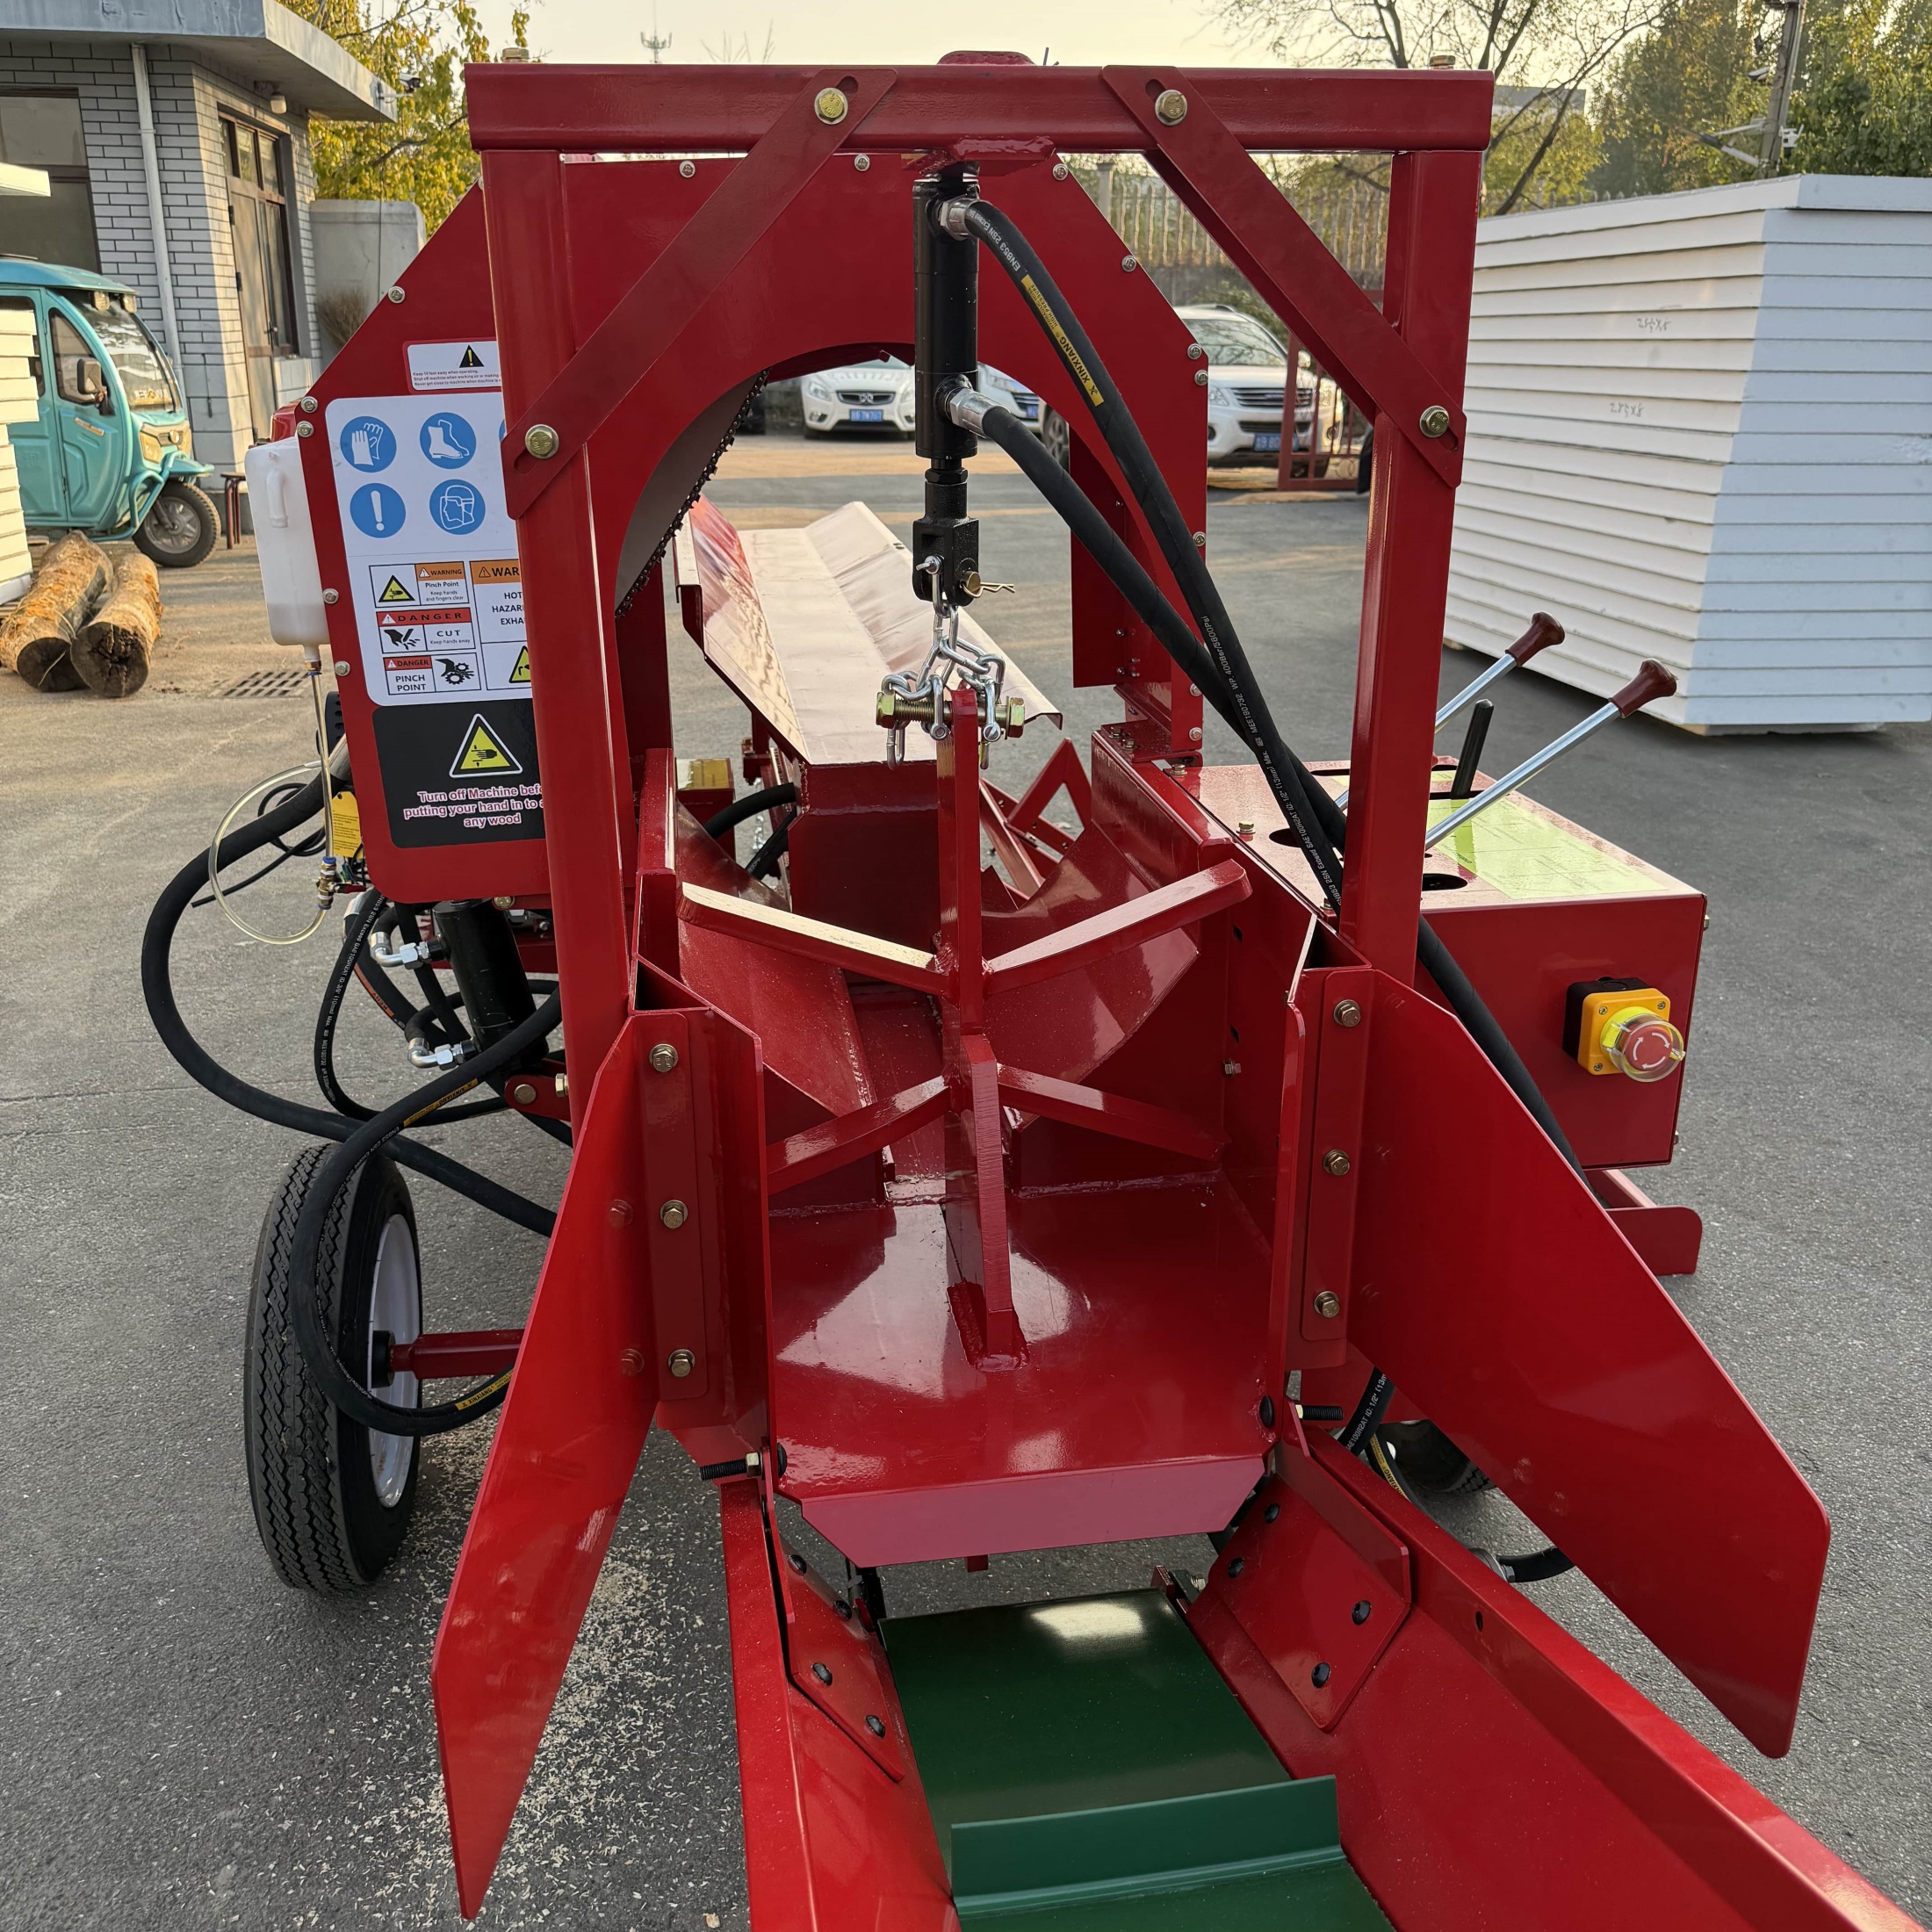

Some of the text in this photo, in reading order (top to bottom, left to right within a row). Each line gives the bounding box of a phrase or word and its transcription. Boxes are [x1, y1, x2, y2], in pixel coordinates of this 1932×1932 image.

[988, 227, 1002, 244] 2SN
[999, 242, 1021, 271] EN853
[1059, 336, 1091, 384] XINXIANG
[492, 604, 523, 613] HAZAR
[398, 613, 463, 622] DANGER
[417, 790, 447, 803] Turn
[449, 789, 467, 801] off
[467, 786, 518, 799] Machine
[403, 797, 537, 819] putting your hand in to
[464, 812, 522, 828] any wood
[1309, 848, 1325, 870] Exceed
[469, 1388, 493, 1405] XINXIANG
